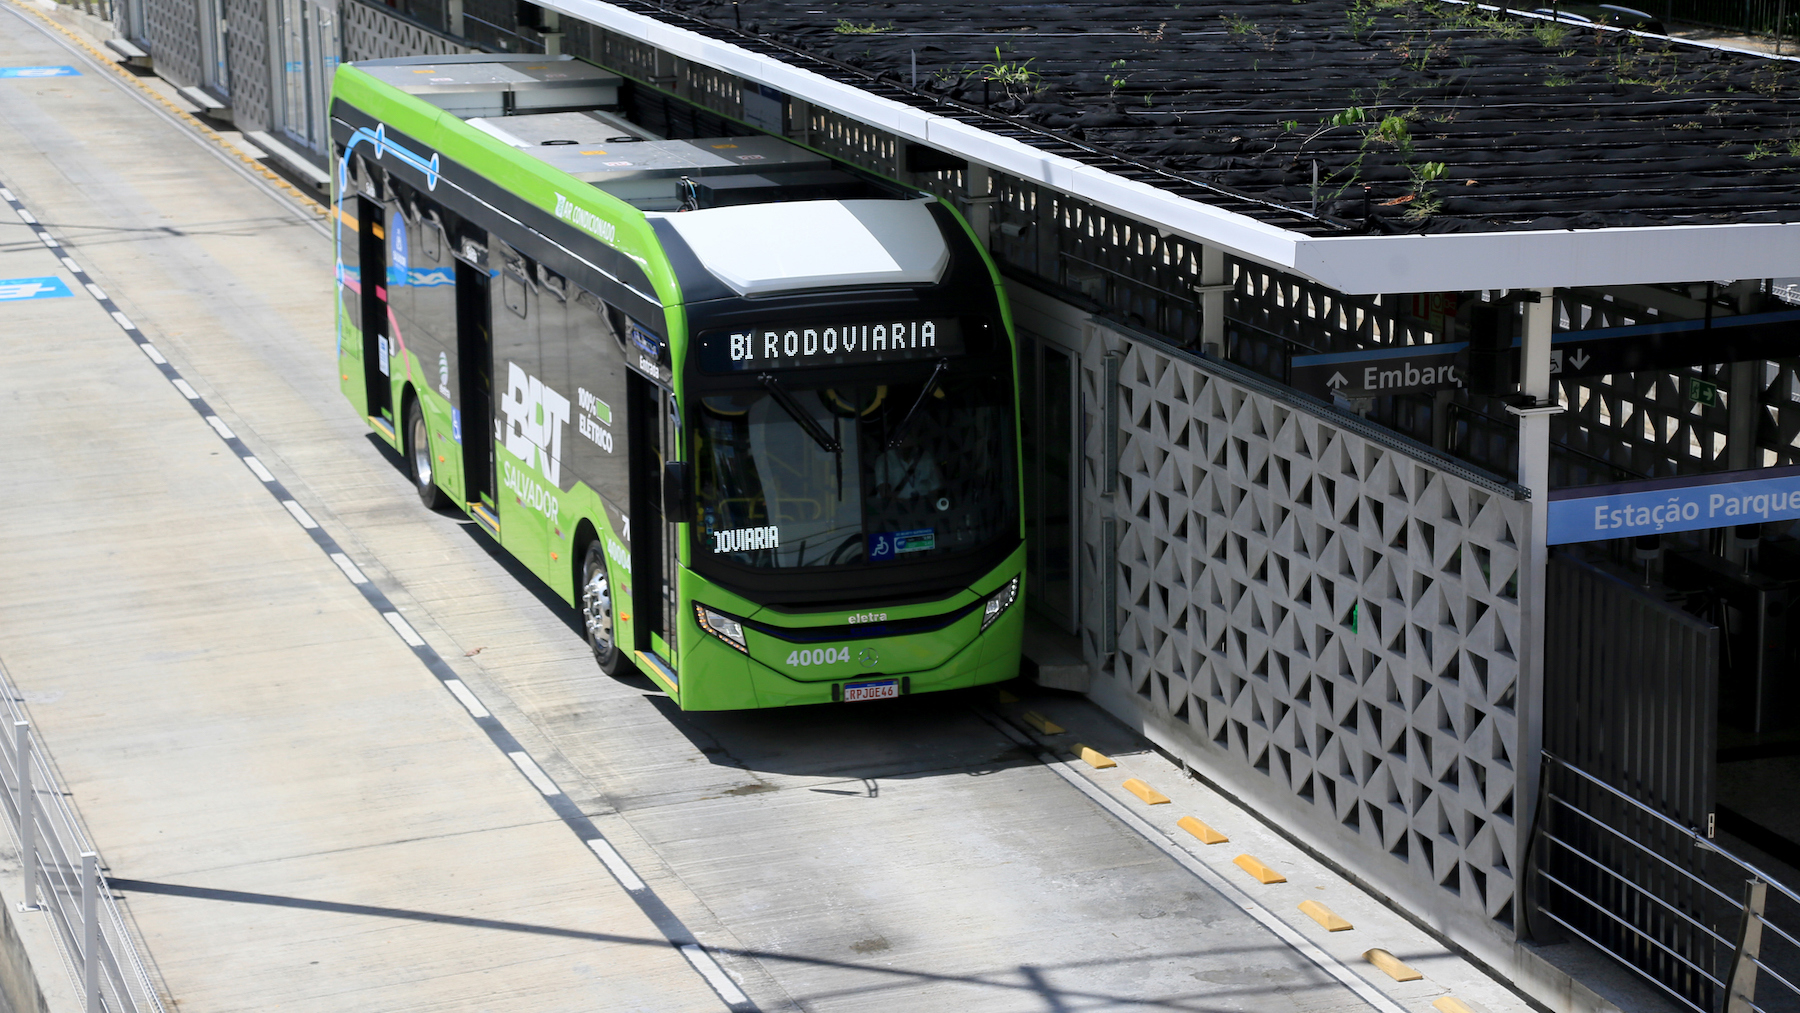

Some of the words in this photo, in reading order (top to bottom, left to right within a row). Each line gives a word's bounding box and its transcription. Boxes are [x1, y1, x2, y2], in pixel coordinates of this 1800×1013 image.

[563, 201, 573, 220] AR
[573, 206, 615, 242] CONDICIONADO
[730, 333, 753, 361] B1
[764, 321, 936, 358] RODOVIARIA
[578, 387, 597, 416] 100%
[501, 361, 570, 488] BRT
[579, 411, 613, 454] ELÉTRICO
[504, 461, 559, 525] SALVADOR
[1594, 497, 1699, 531] Estação
[1709, 490, 1800, 519] Parque
[608, 539, 631, 575] 40004
[848, 612, 887, 624] eletra
[786, 646, 850, 667] 40004
